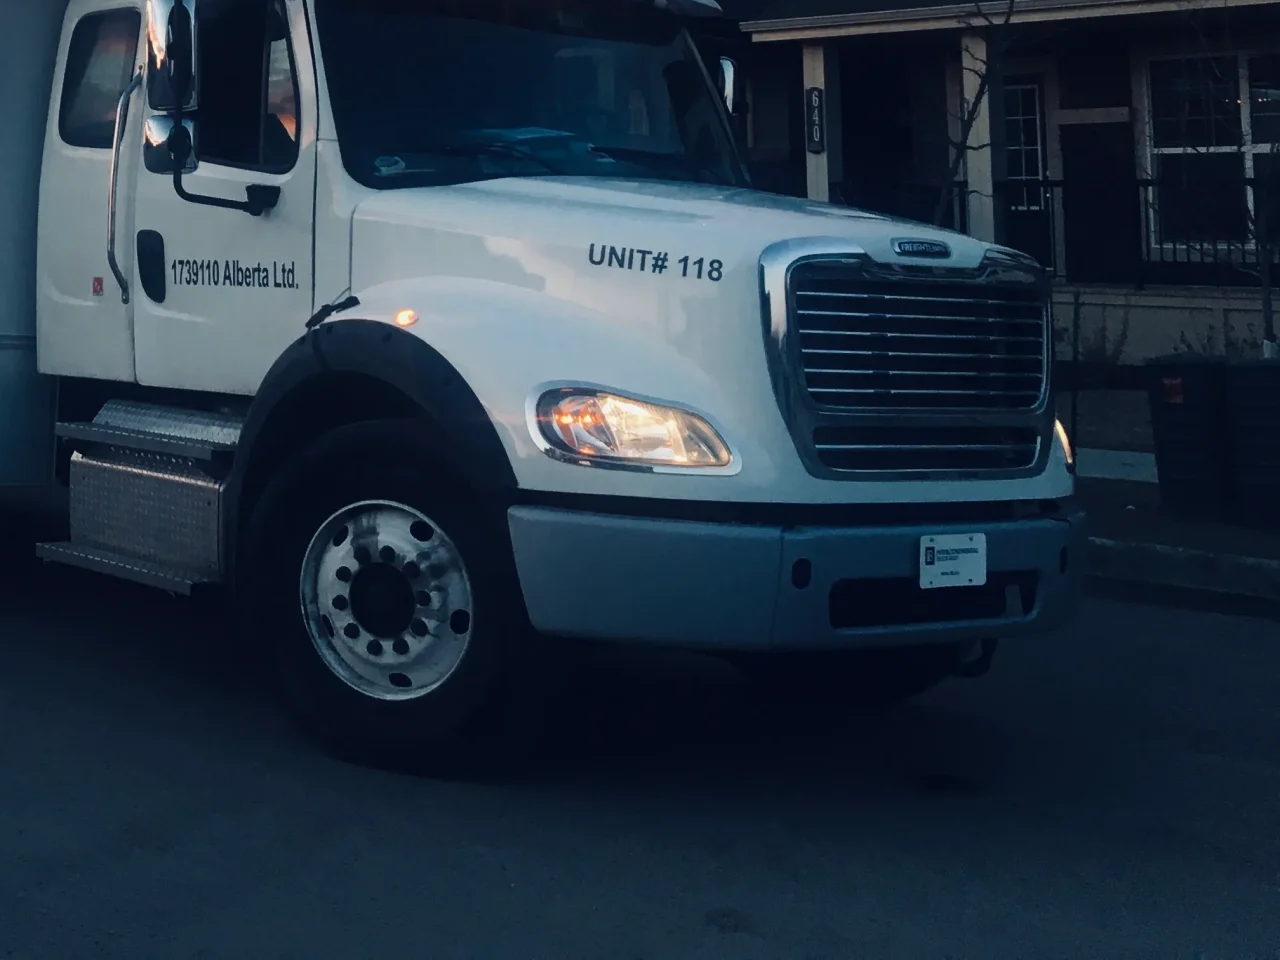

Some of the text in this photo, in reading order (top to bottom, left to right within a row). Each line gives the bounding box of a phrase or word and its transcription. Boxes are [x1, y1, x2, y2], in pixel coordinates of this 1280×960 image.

[172, 259, 299, 289] 1739110 Alberta Ltd.
[588, 243, 723, 281] UNIT# 118
